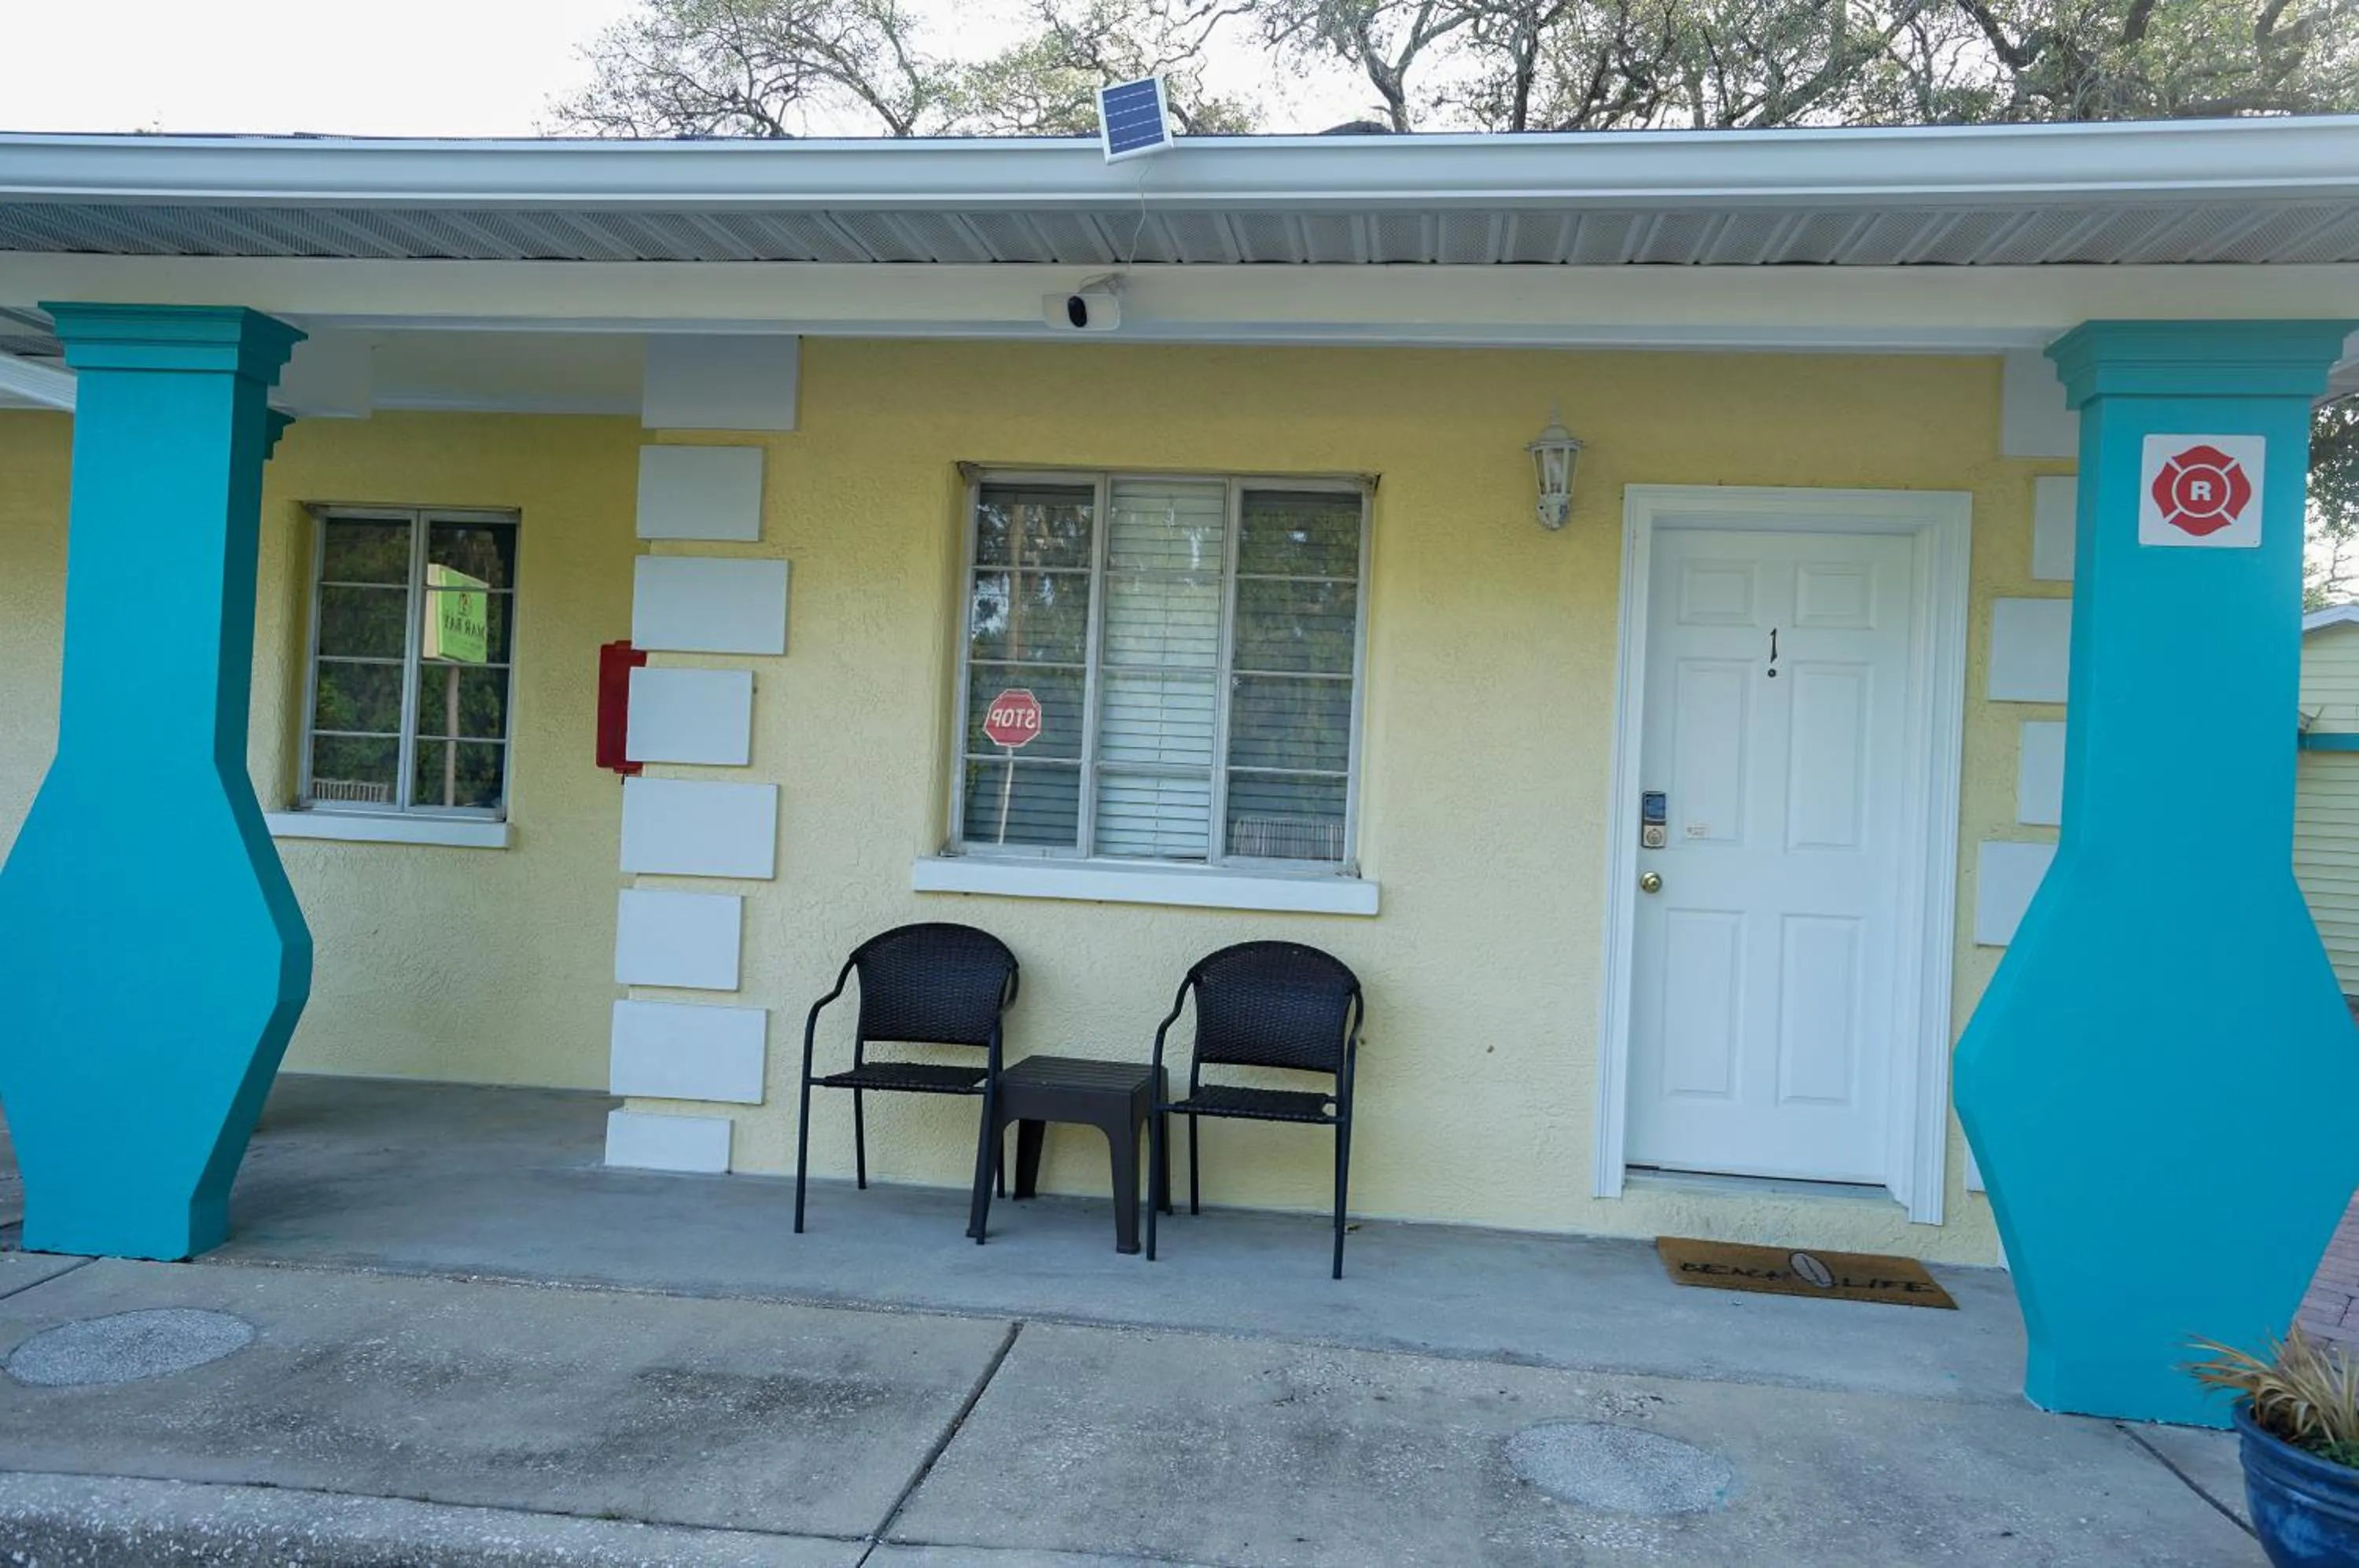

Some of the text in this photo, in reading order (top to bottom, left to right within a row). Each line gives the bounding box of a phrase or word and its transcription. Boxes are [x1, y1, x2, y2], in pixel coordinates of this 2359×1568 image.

[2190, 480, 2212, 501] R
[1770, 628, 1778, 664] 1
[1842, 1277, 1938, 1293] LIFE
